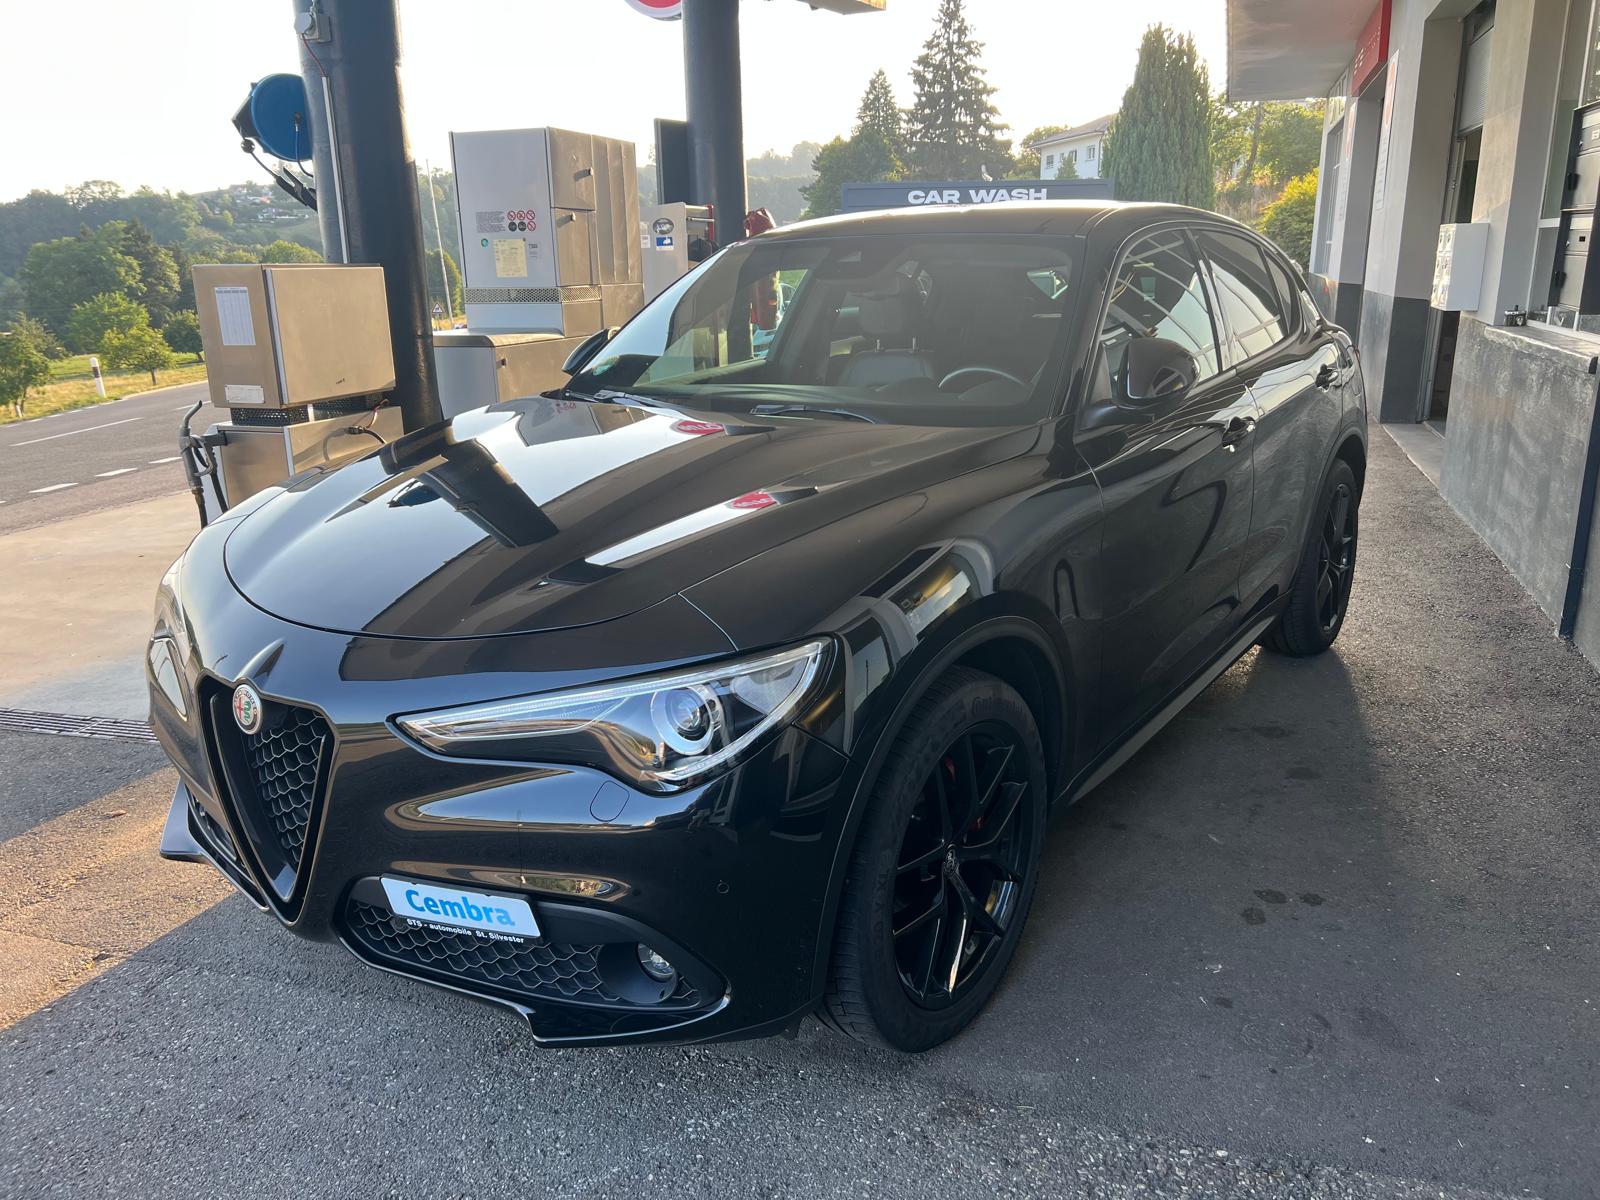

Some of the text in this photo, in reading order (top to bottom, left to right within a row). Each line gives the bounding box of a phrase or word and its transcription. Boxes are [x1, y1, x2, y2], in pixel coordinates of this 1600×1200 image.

[907, 188, 1047, 204] CAR WASH
[405, 889, 516, 926] Cembra
[406, 918, 423, 928] STS
[488, 932, 524, 944] Silvester
